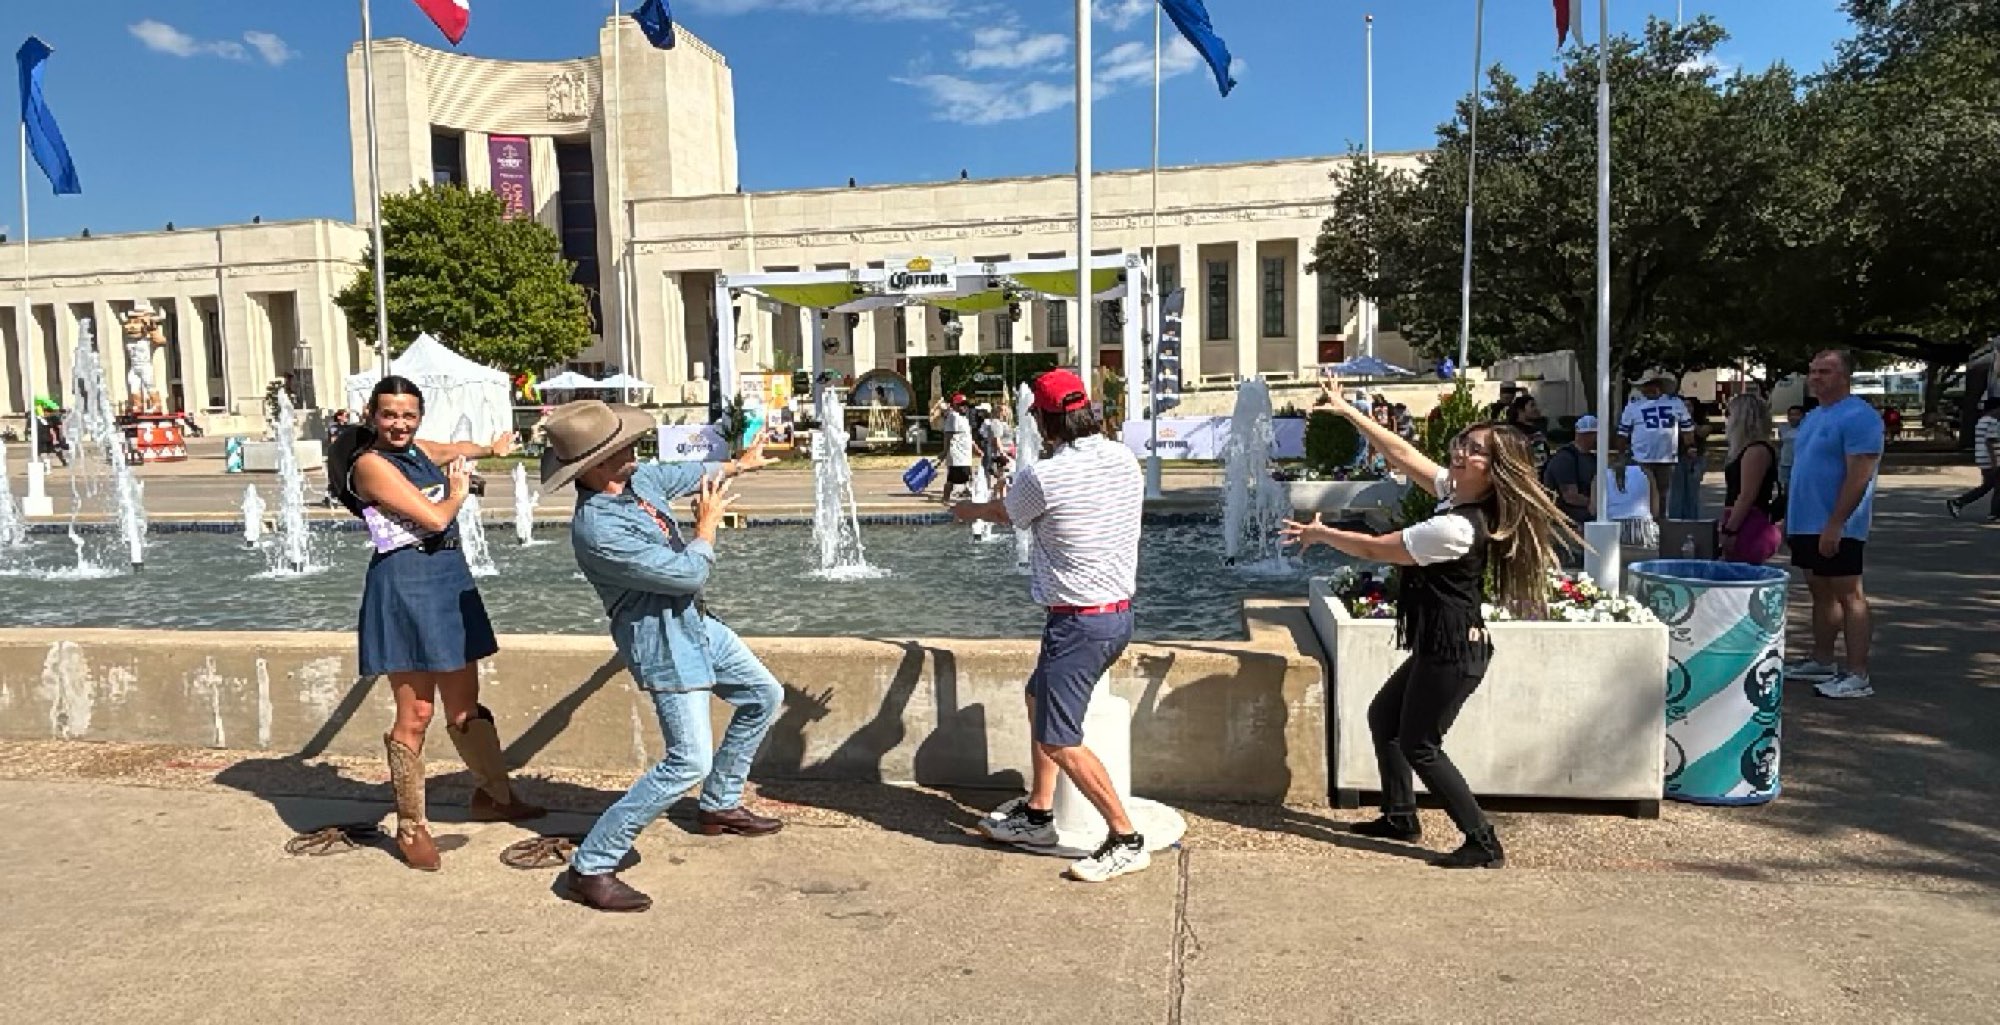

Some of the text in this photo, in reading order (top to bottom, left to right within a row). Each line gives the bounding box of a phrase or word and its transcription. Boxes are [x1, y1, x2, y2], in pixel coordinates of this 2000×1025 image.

[889, 271, 949, 290] Corona
[1641, 405, 1676, 429] 55
[676, 442, 714, 456] Corona
